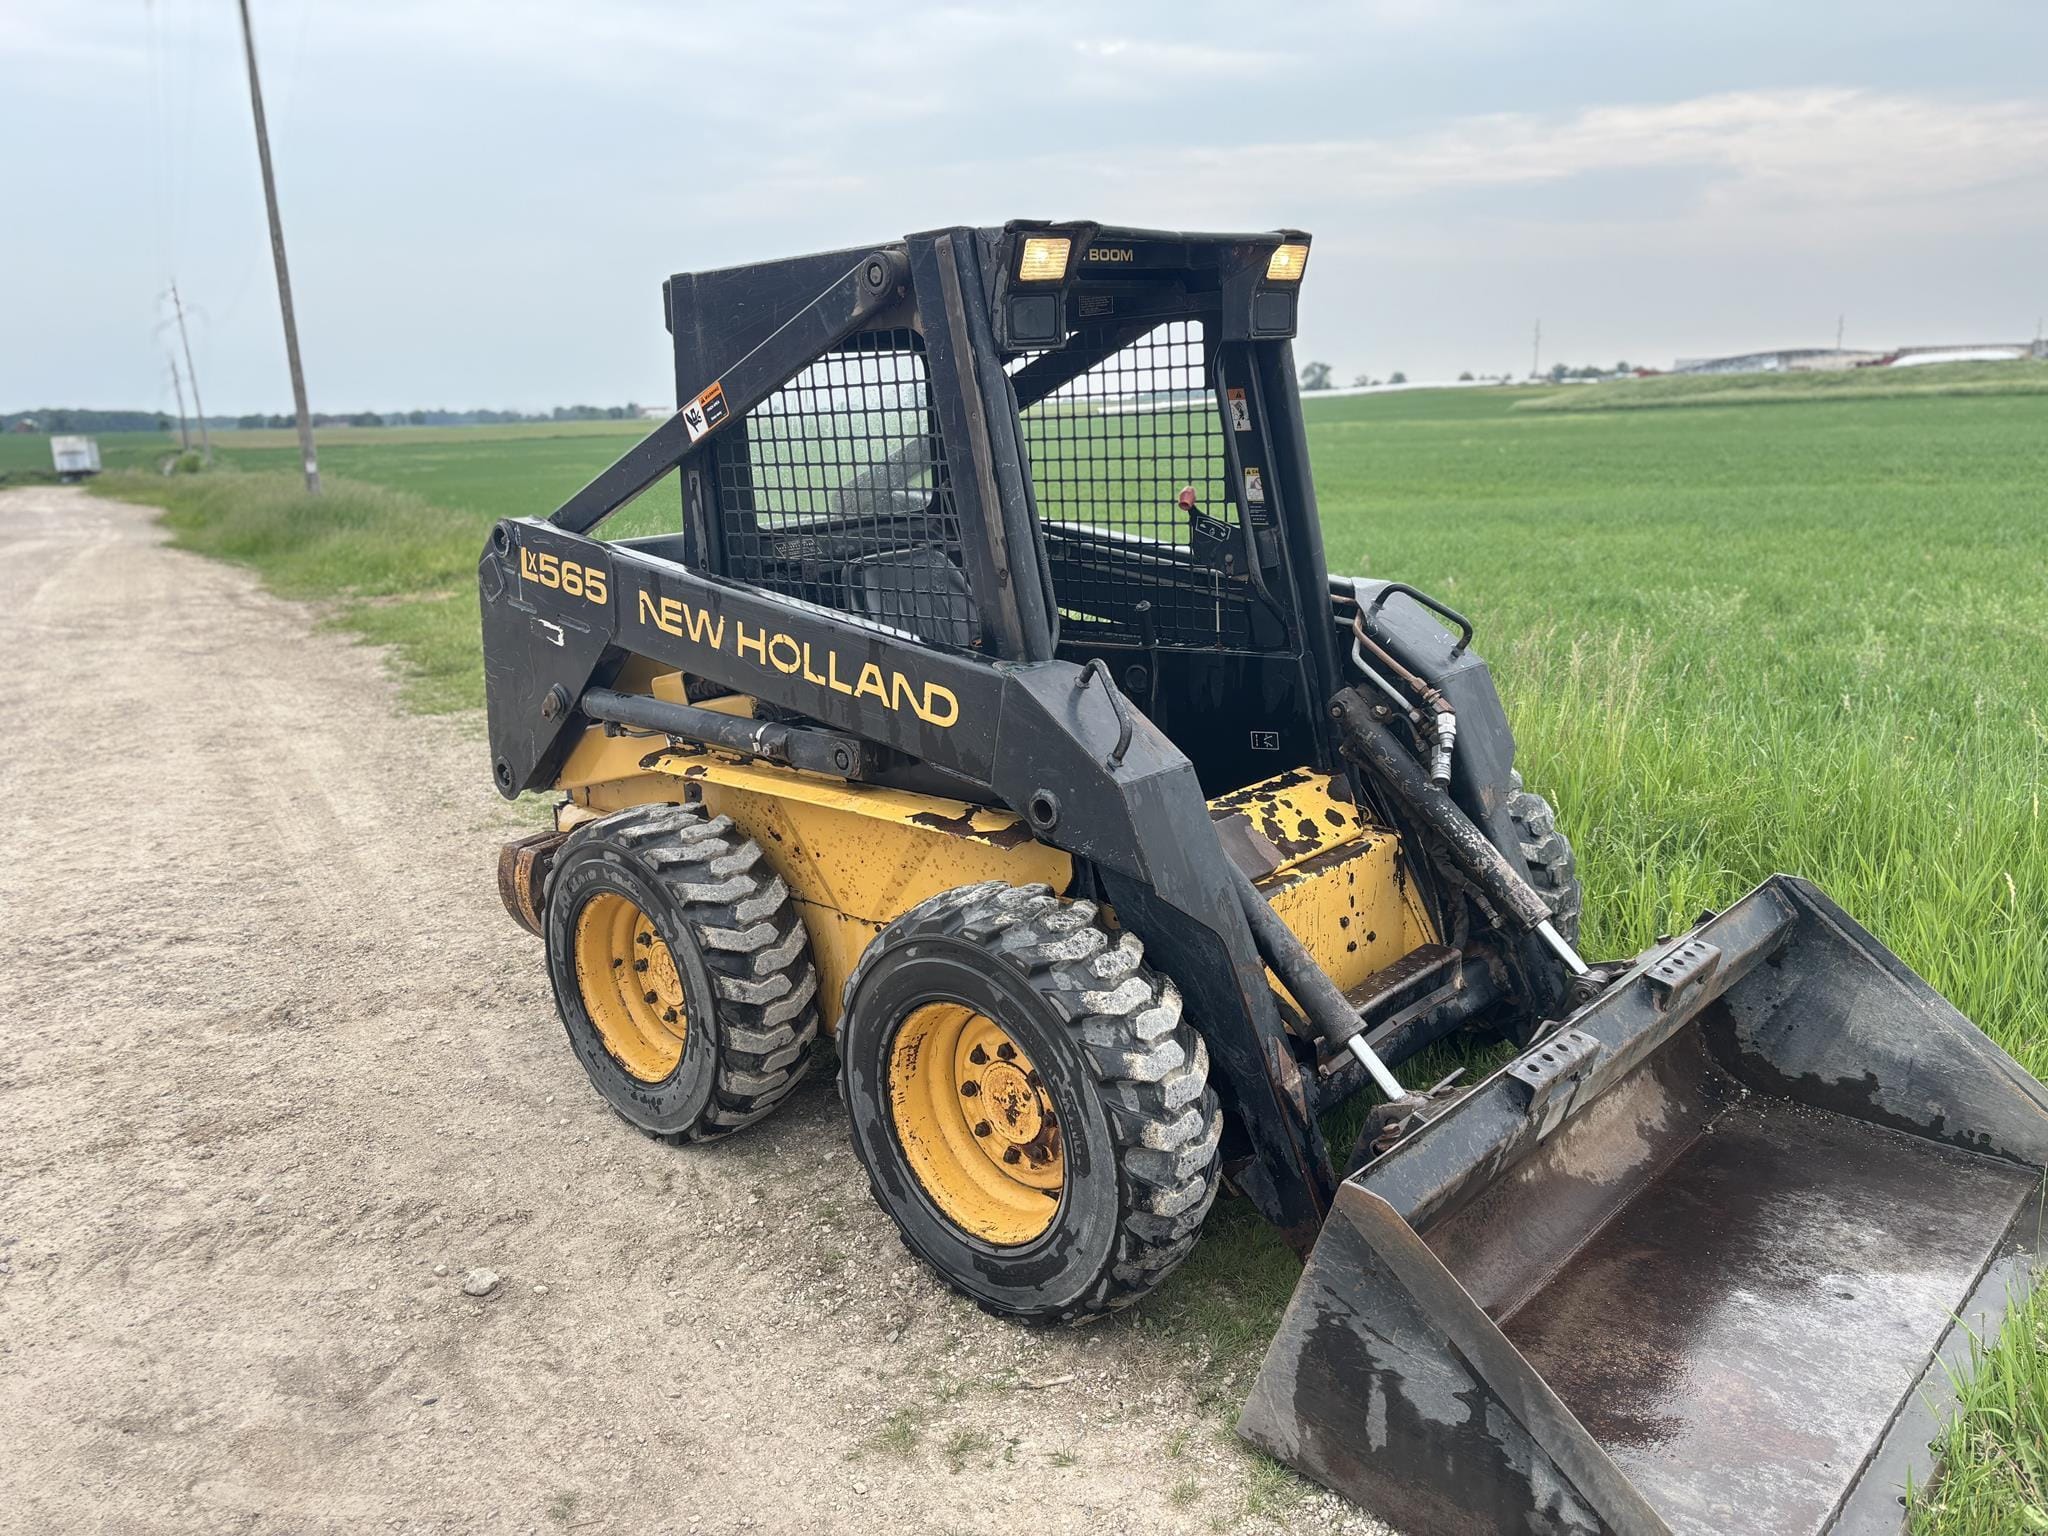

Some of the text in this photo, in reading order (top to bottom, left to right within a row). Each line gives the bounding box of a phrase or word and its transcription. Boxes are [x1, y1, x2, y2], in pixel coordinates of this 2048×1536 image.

[1089, 248, 1133, 262] BOOM
[639, 589, 959, 728] NEW HOLLAND
